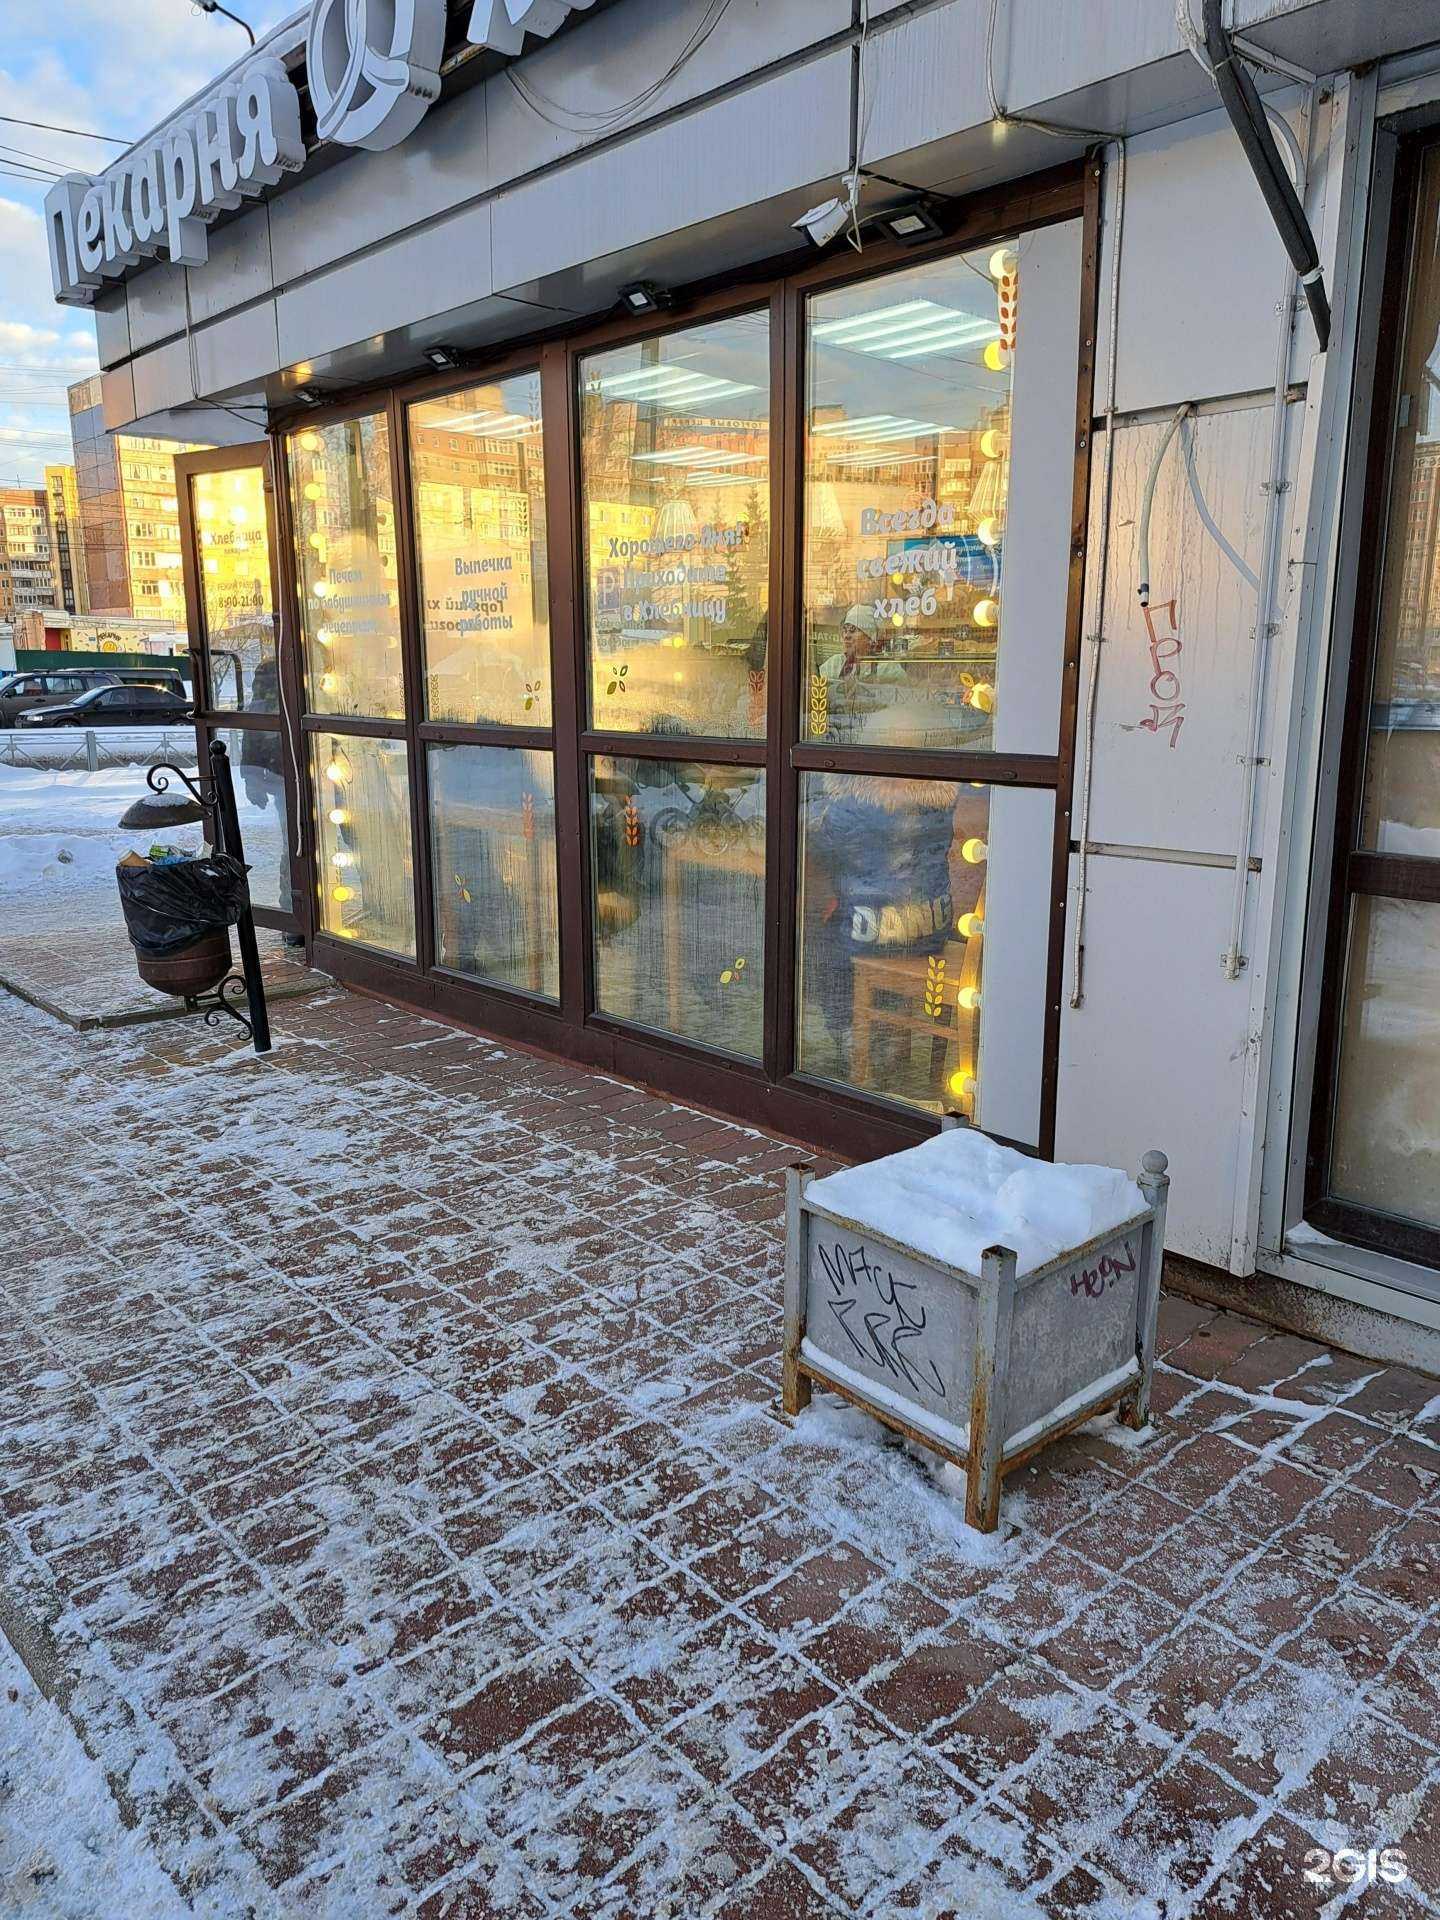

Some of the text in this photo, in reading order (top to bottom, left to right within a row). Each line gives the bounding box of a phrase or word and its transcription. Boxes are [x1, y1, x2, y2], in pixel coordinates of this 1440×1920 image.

[44, 72, 288, 302] Пекарня
[861, 498, 955, 535] Всегда
[609, 533, 696, 561] Хорошего
[857, 541, 957, 577] свежий
[455, 556, 512, 576] Выпечка
[218, 594, 264, 608] 8:00-21:00
[461, 582, 508, 604] ручной
[873, 588, 937, 618] хлеб
[460, 613, 513, 636] работы
[638, 598, 726, 624] Хлебницу
